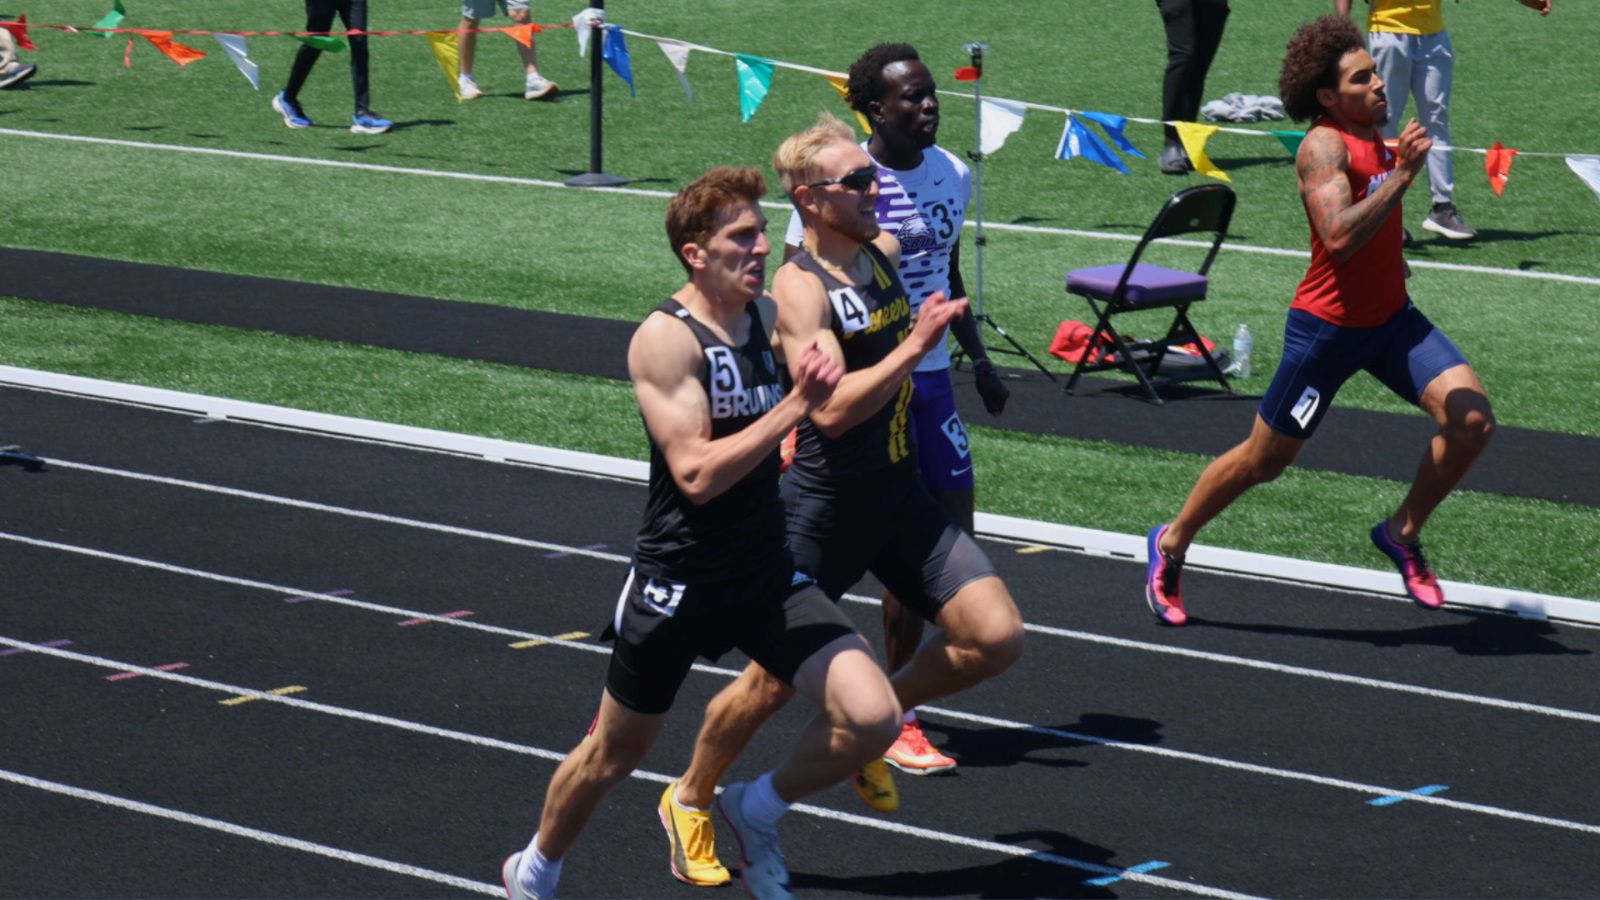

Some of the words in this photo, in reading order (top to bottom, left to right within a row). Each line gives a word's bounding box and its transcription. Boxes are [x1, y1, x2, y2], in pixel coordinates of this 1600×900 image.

[932, 204, 954, 239] 3
[840, 291, 866, 325] 4
[712, 350, 736, 392] 5
[711, 383, 784, 419] BRUINS
[947, 417, 969, 451] 3
